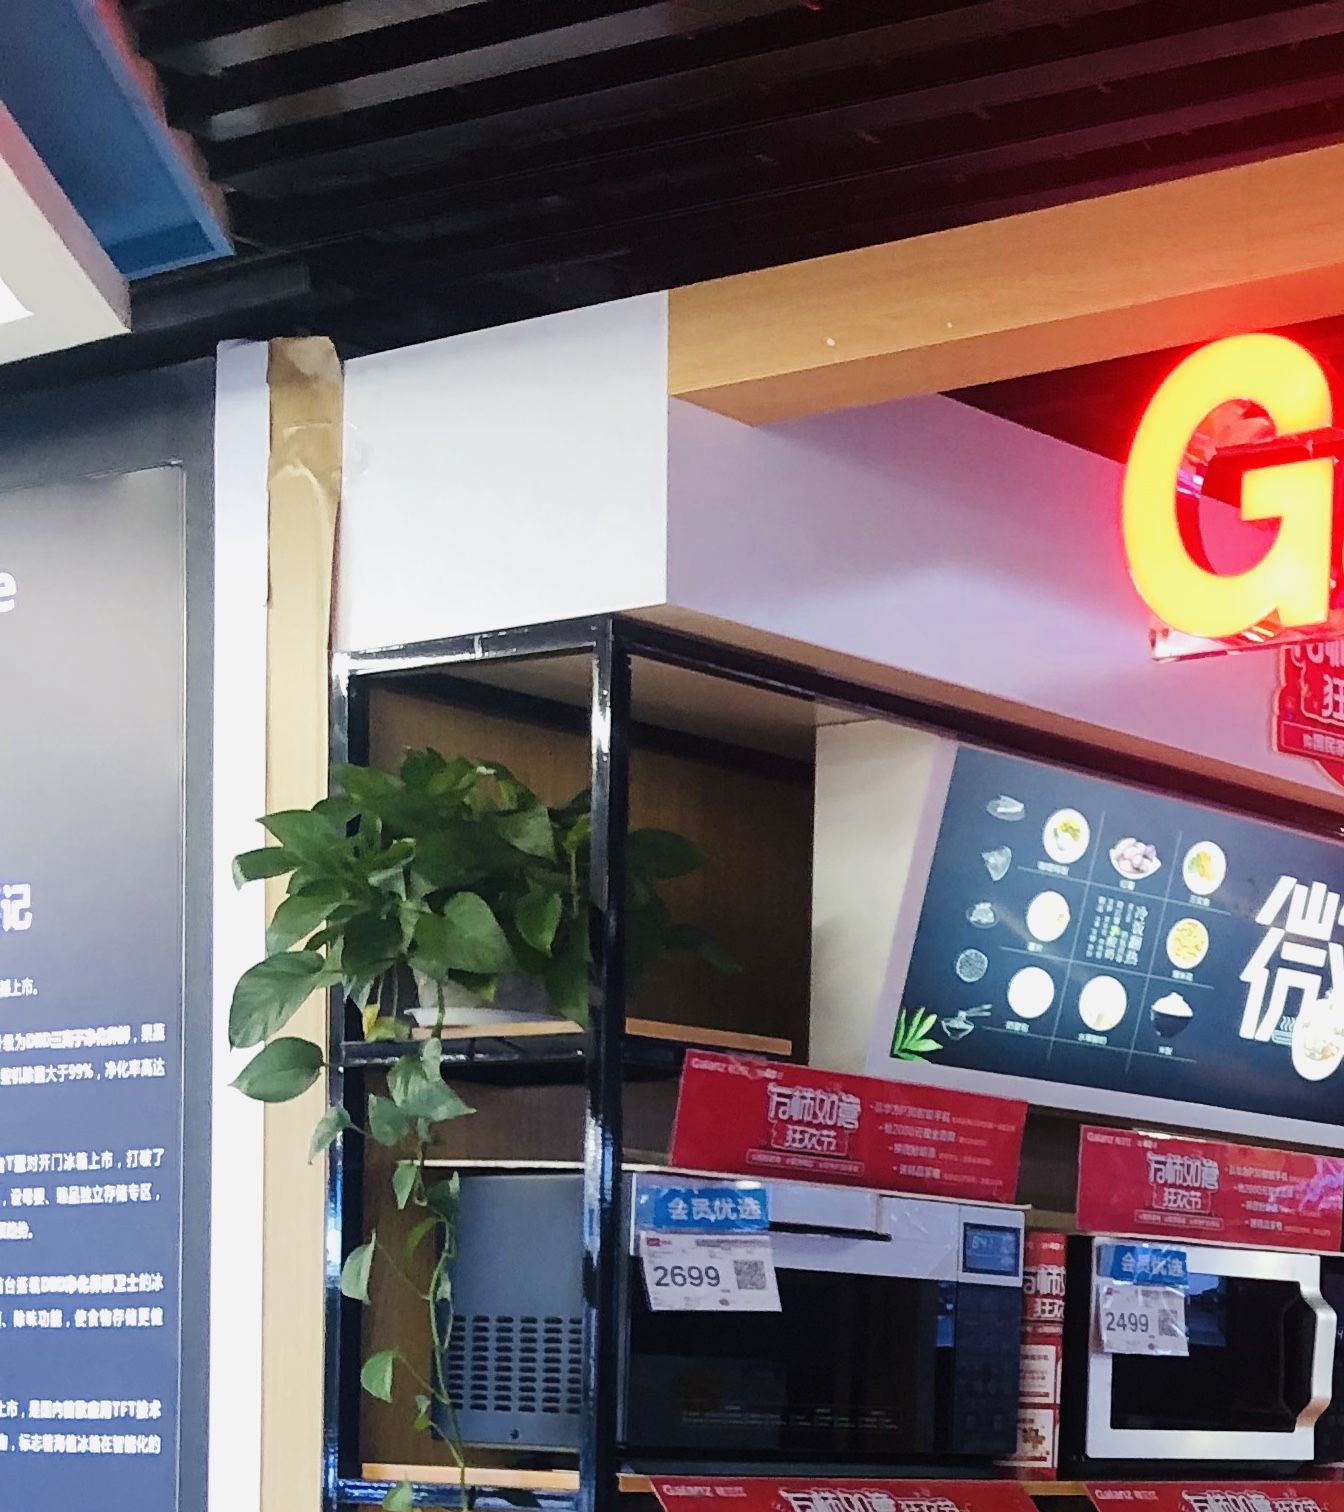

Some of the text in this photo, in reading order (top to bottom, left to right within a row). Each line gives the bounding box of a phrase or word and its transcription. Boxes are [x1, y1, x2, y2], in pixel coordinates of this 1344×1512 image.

[785, 1126, 837, 1152] 狂欢节
[666, 1195, 763, 1222] 会员优选
[1163, 1187, 1202, 1209] 狂欢节
[1119, 1250, 1184, 1276] 会员优选
[653, 1265, 721, 1288] 2699
[1104, 1311, 1150, 1333] 2499
